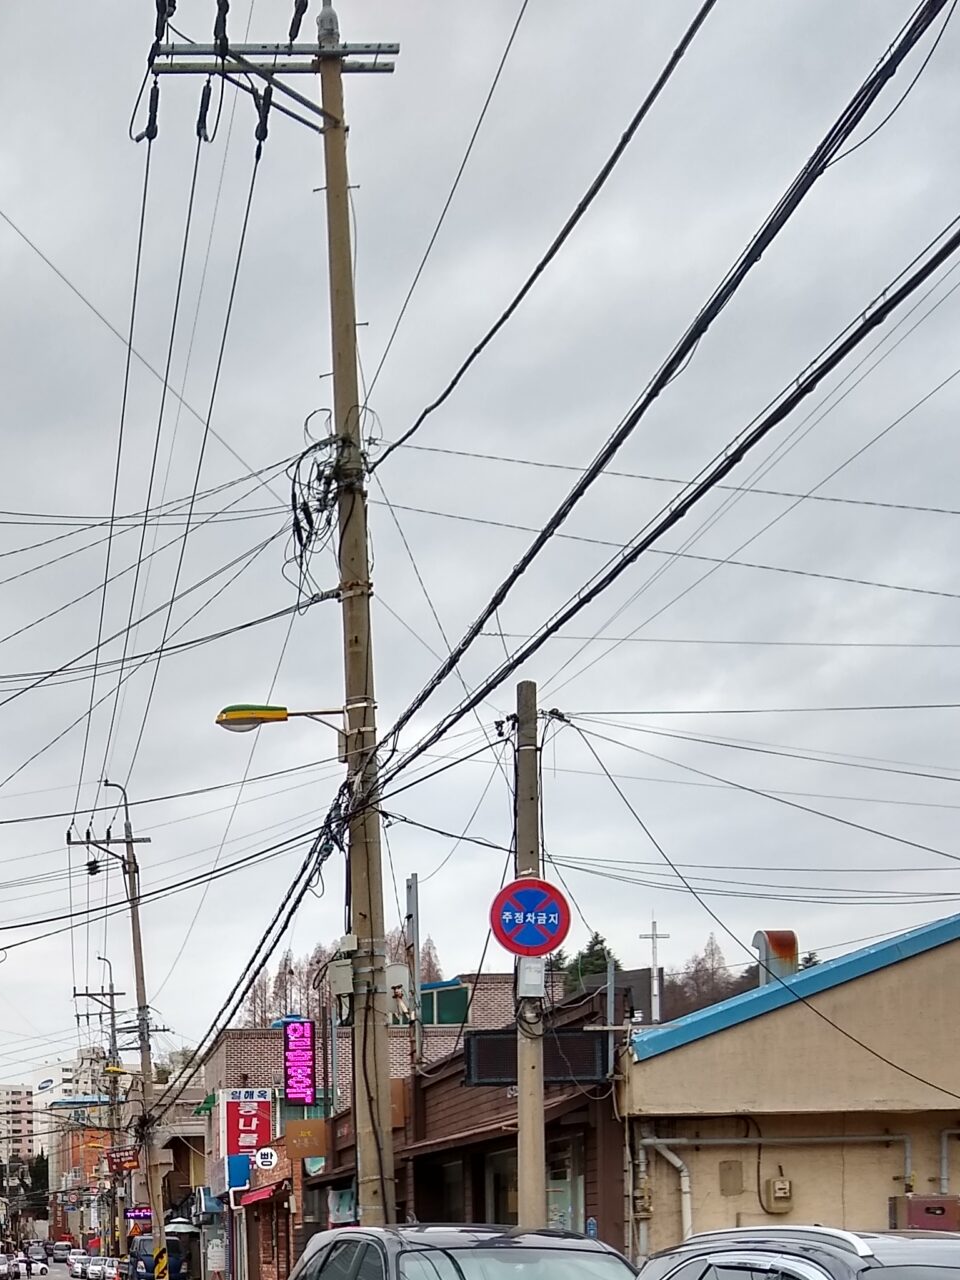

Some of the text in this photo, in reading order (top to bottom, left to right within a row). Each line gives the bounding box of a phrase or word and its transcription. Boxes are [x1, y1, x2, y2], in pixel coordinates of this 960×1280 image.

[502, 911, 559, 925] 주정차금지
[230, 1090, 268, 1100] 일해옥
[259, 1151, 274, 1167] 빵
